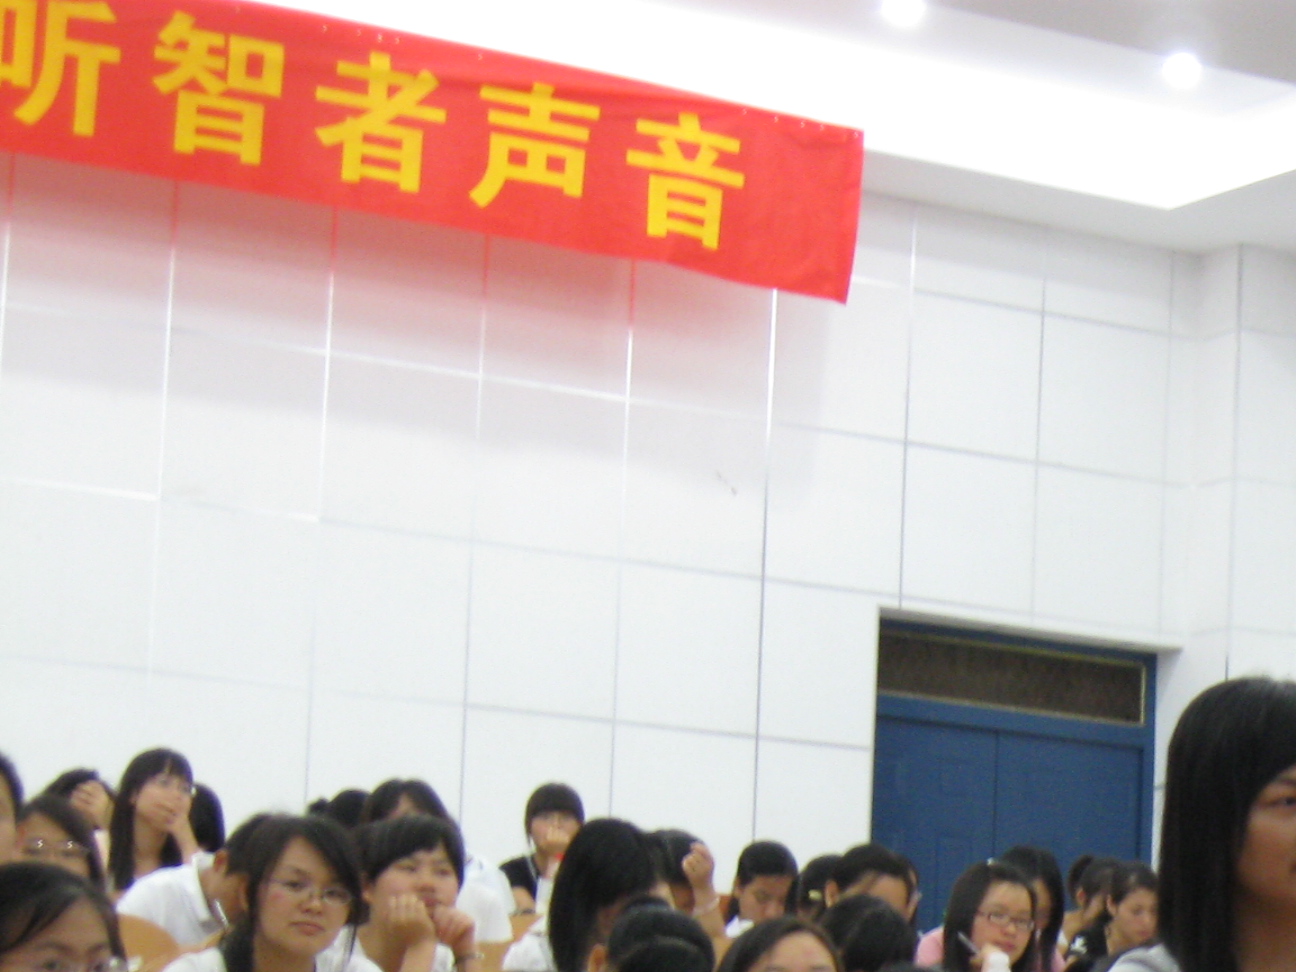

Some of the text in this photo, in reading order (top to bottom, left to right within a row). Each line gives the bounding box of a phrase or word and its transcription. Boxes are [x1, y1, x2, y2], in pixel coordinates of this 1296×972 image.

[0, 0, 744, 249] 听智者声音
